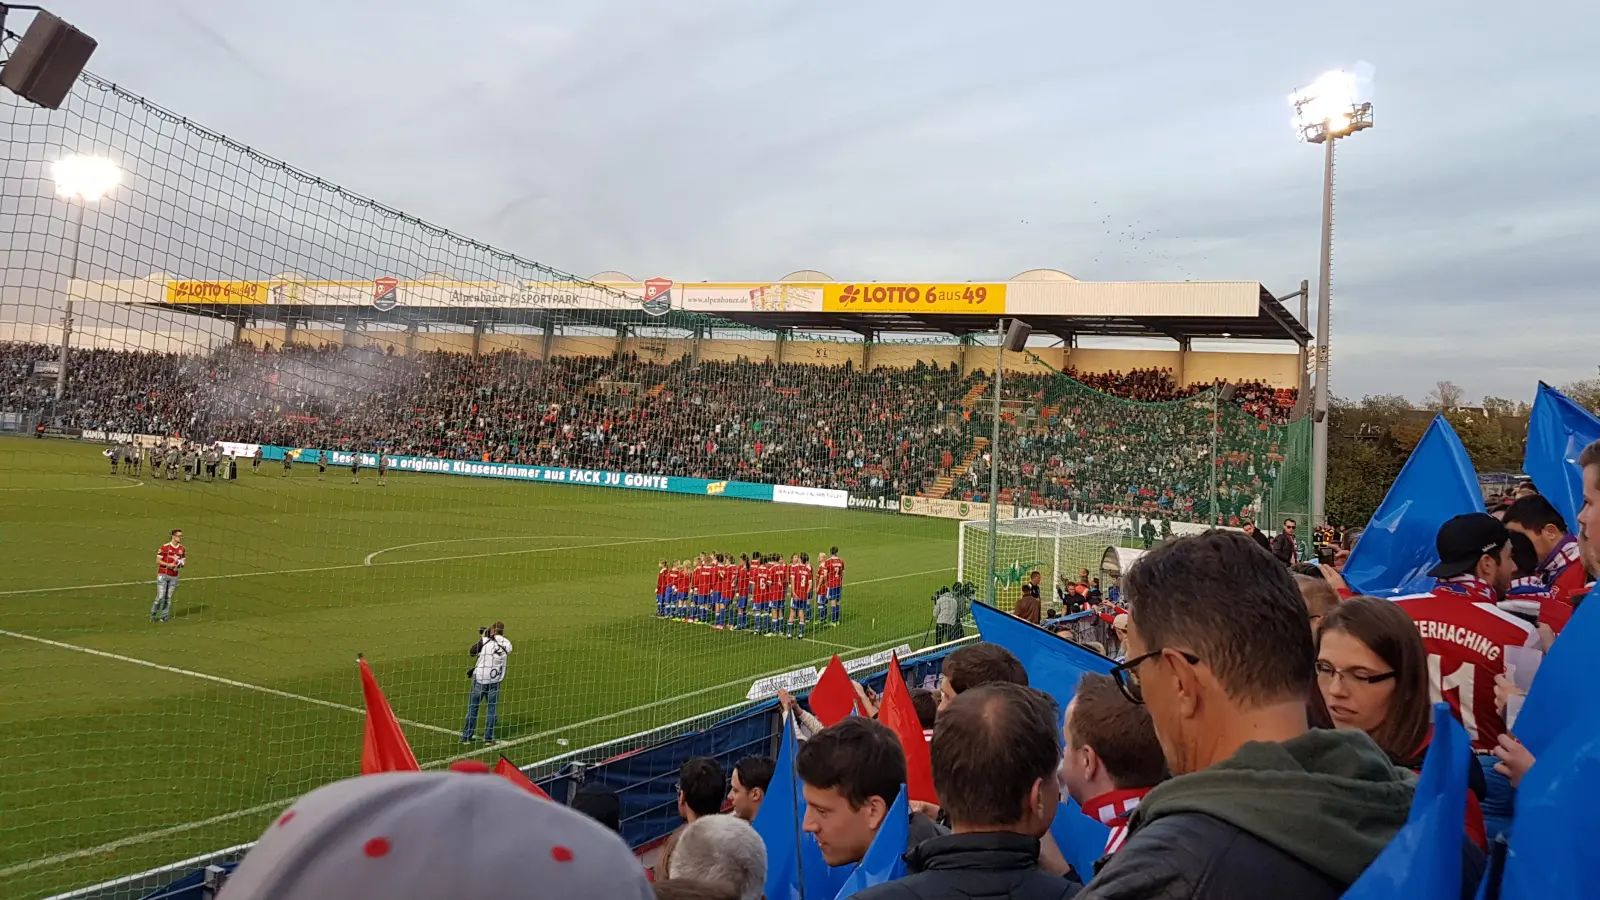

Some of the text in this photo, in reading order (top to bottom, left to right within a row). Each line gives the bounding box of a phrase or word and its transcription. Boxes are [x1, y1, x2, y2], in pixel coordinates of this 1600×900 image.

[188, 283, 221, 297] LOTTO
[451, 290, 580, 305] Alpenbauer SPORTPARK
[863, 286, 920, 304] LOTTO
[688, 296, 748, 305] www.alpenbauer.de
[400, 458, 450, 472] originale
[453, 461, 541, 478] Klassenzimmer
[544, 470, 566, 480] aus
[570, 470, 601, 484] FACK
[605, 473, 620, 485] JU
[848, 495, 877, 508] bwin
[1018, 508, 1072, 524] KAMPA
[1077, 513, 1133, 530] KAMPA
